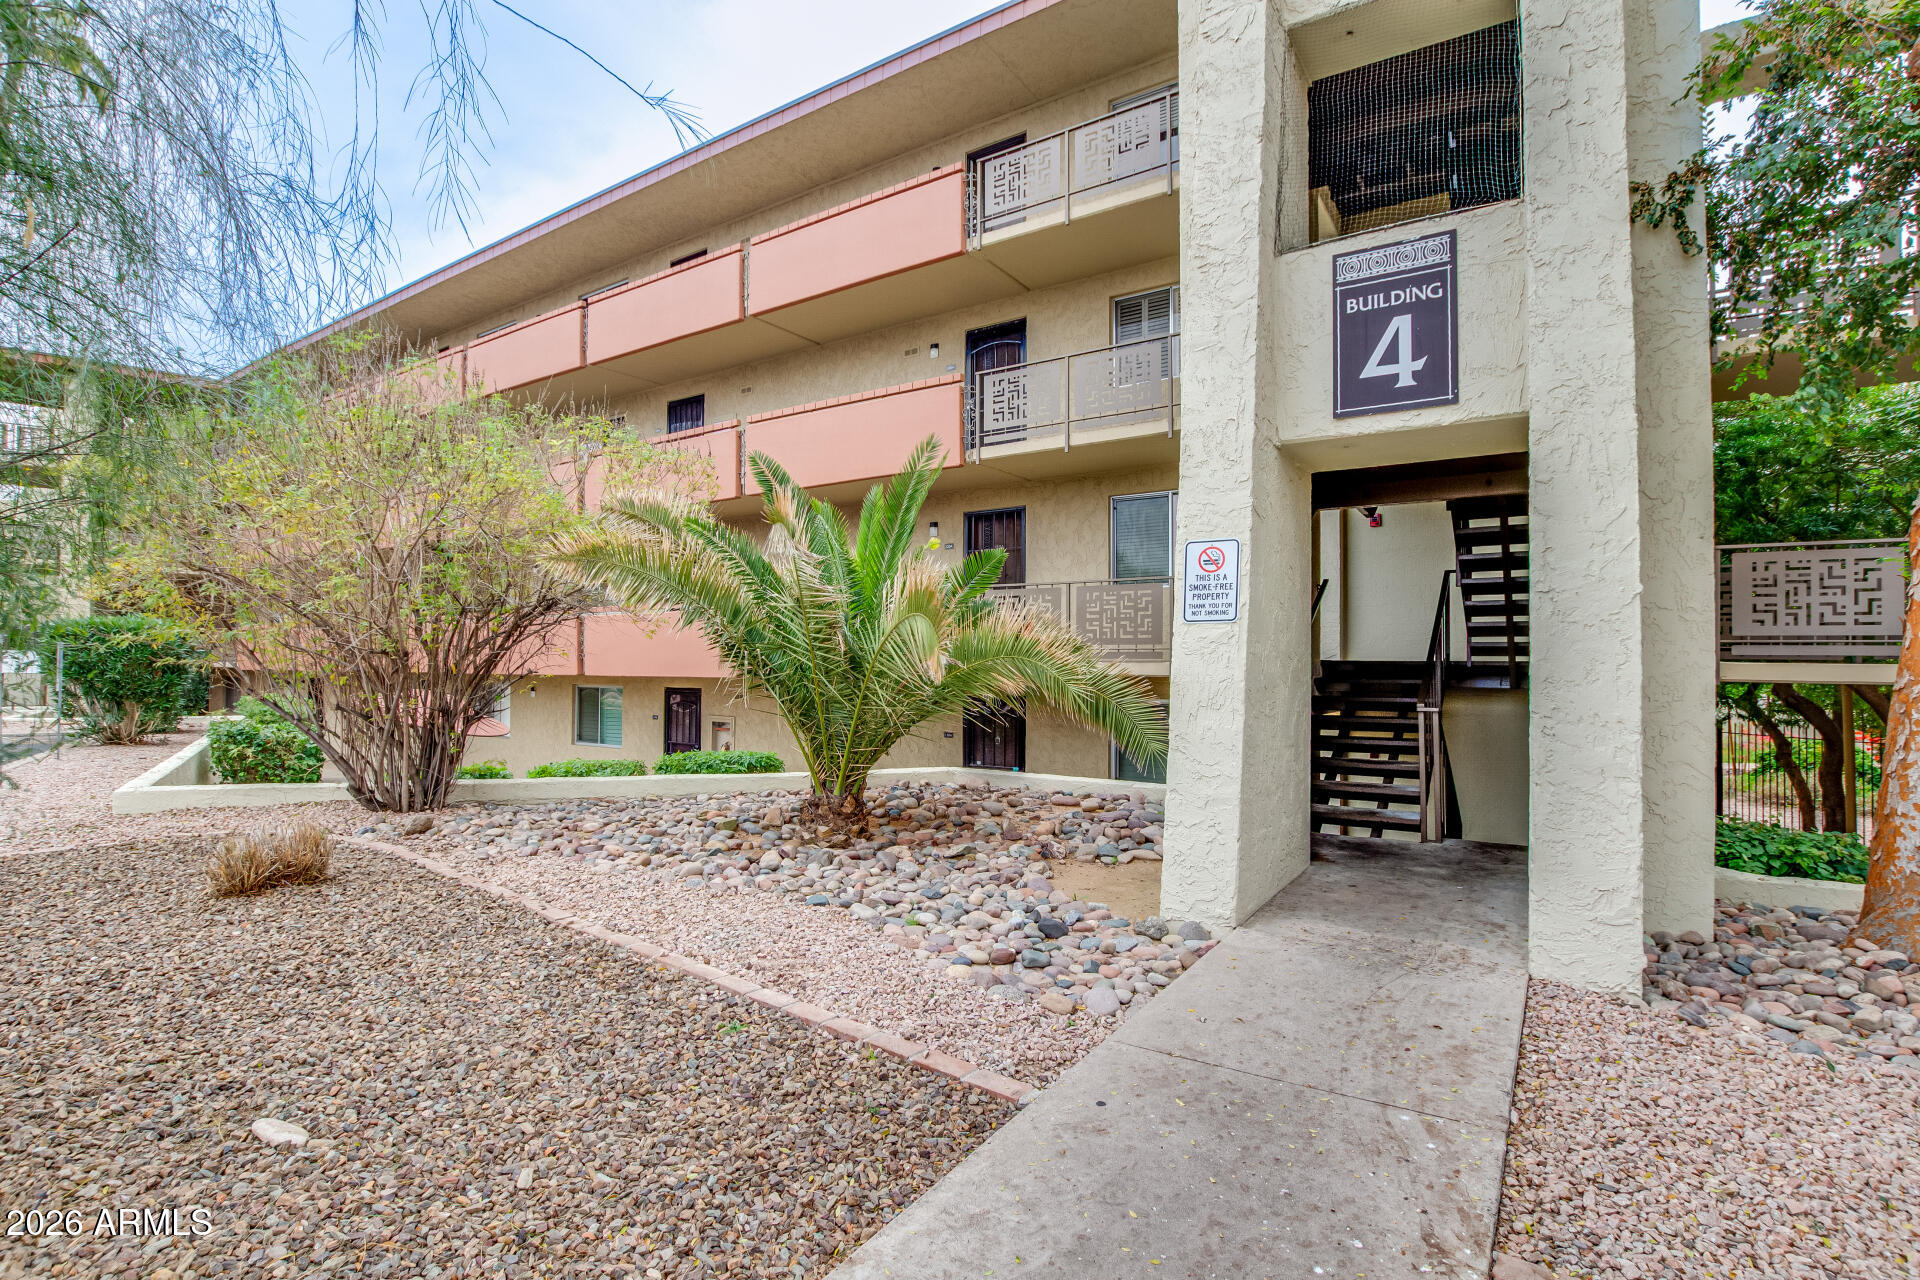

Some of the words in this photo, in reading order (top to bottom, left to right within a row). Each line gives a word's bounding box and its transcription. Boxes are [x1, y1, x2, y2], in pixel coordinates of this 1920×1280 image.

[1346, 283, 1443, 314] BUILDING
[1359, 313, 1428, 388] 4
[1195, 574, 1211, 582] THIS
[1213, 573, 1220, 581] IS
[1223, 573, 1228, 581] A
[1188, 583, 1234, 592] SMOKE-FREE
[1192, 592, 1229, 601] PROPERTY
